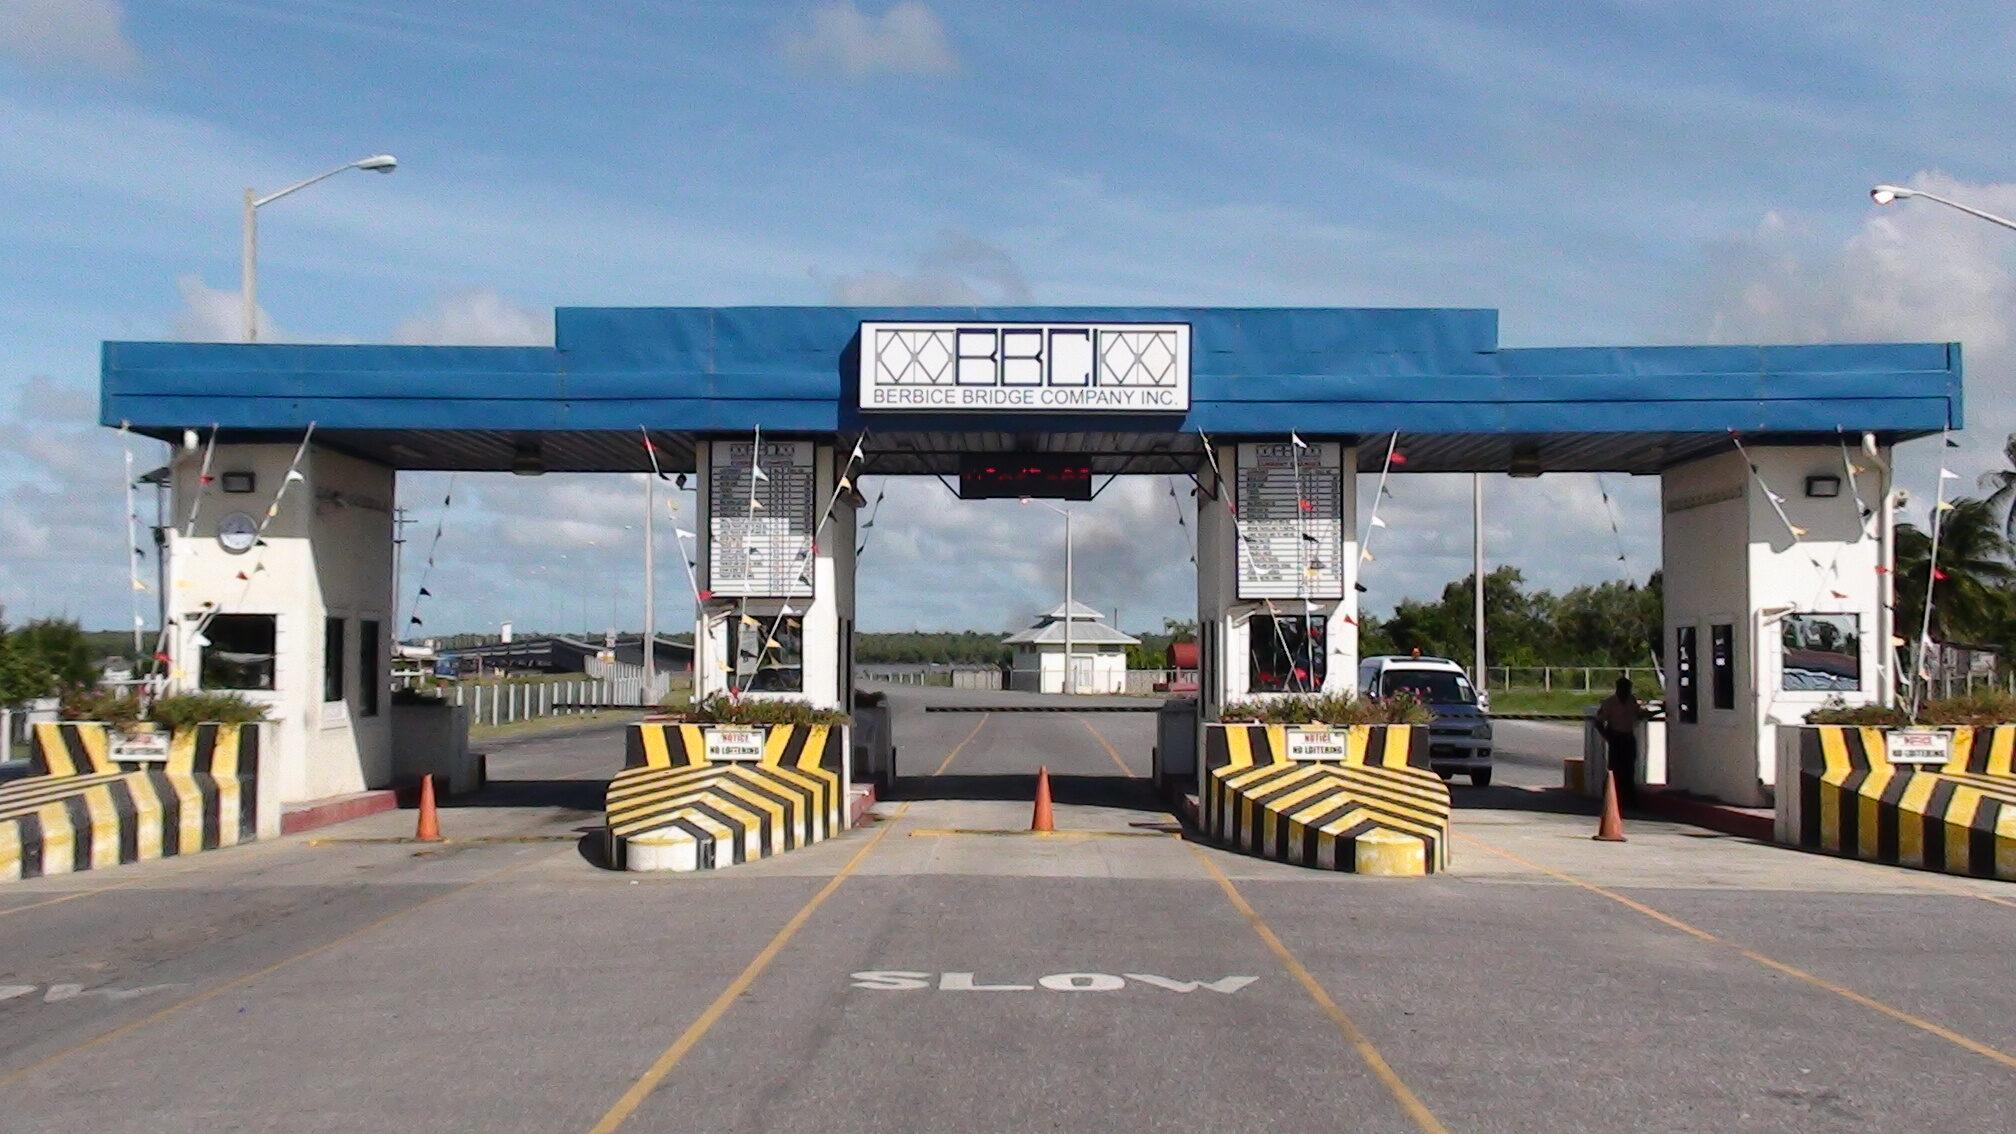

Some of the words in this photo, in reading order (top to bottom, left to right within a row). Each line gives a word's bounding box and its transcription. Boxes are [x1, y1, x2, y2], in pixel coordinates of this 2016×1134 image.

[874, 388, 956, 404] BERBICE
[963, 388, 1035, 405] BRIDGE
[1041, 389, 1135, 405] COMPANY
[1142, 390, 1178, 406] INC.
[709, 746, 720, 755] NO
[1293, 745, 1303, 754] NO
[849, 970, 1260, 995] SLOW
